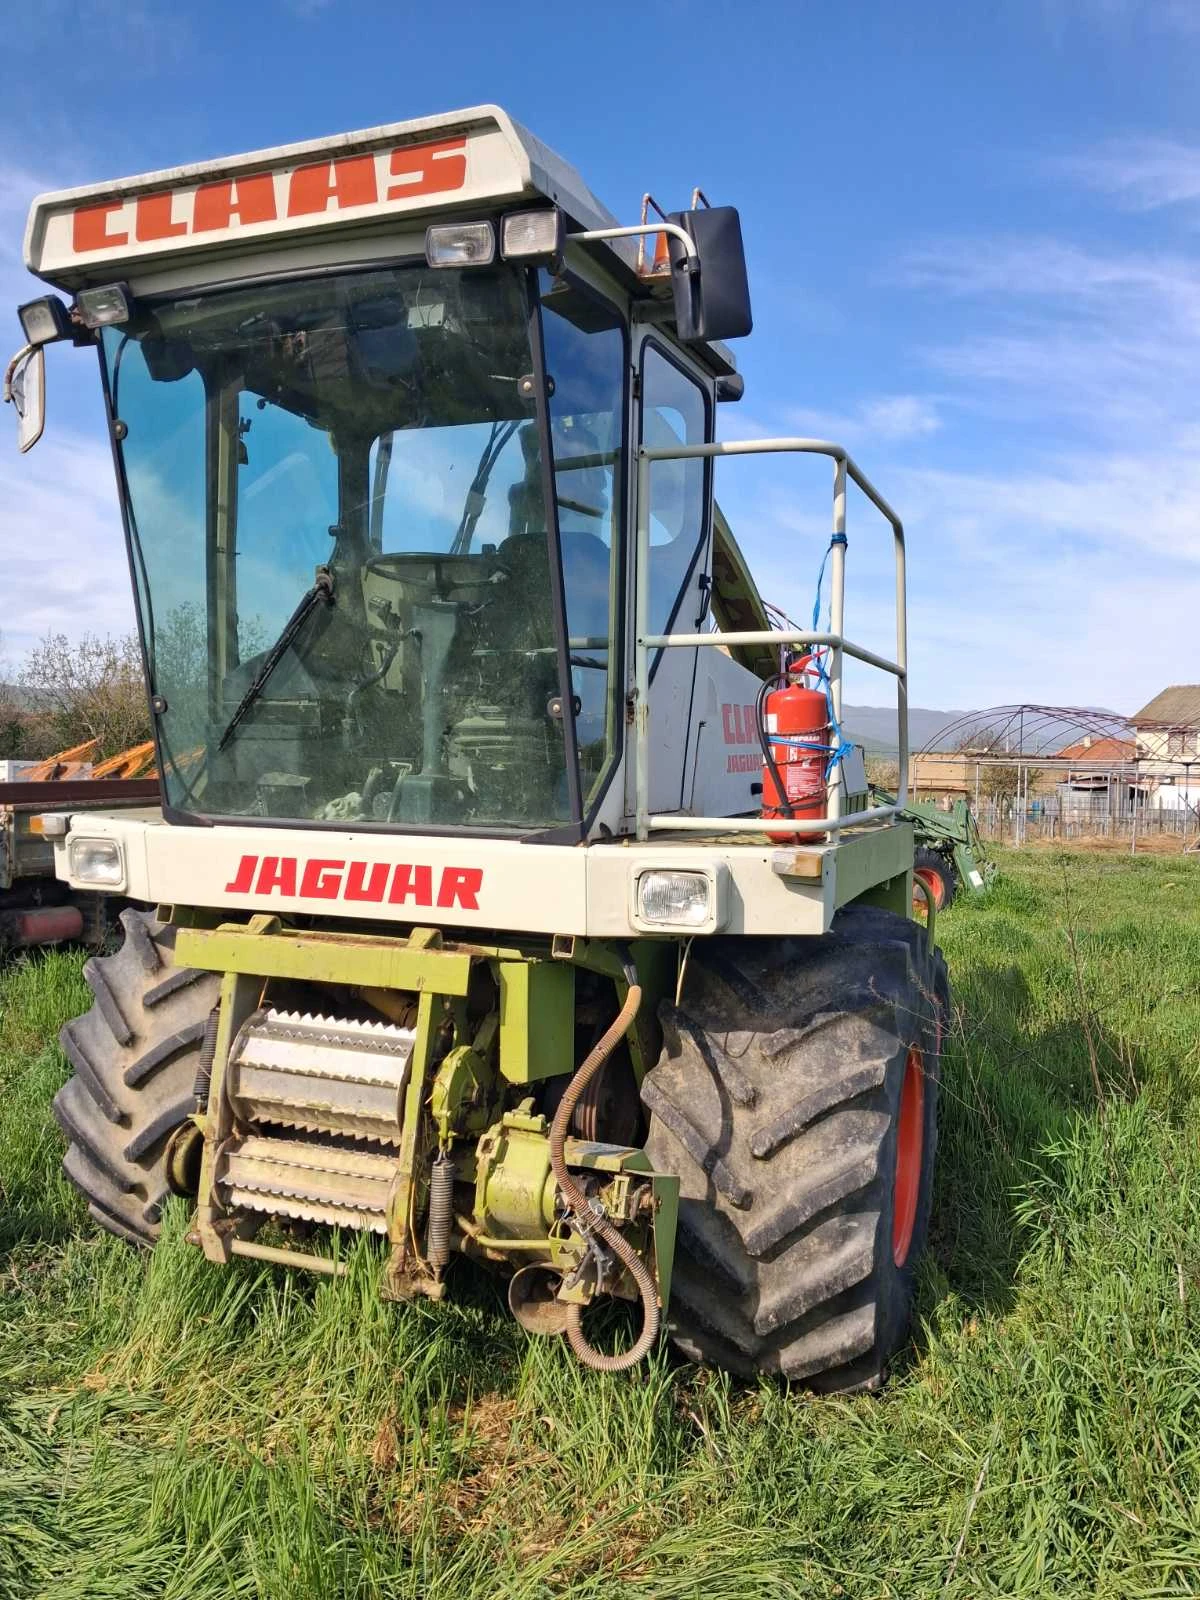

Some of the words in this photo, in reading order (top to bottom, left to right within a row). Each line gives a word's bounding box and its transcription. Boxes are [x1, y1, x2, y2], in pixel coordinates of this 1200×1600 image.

[73, 138, 466, 252] CLAAS
[722, 704, 760, 744] CLA
[727, 754, 762, 773] JAGUA
[225, 855, 483, 910] JAGUAR
